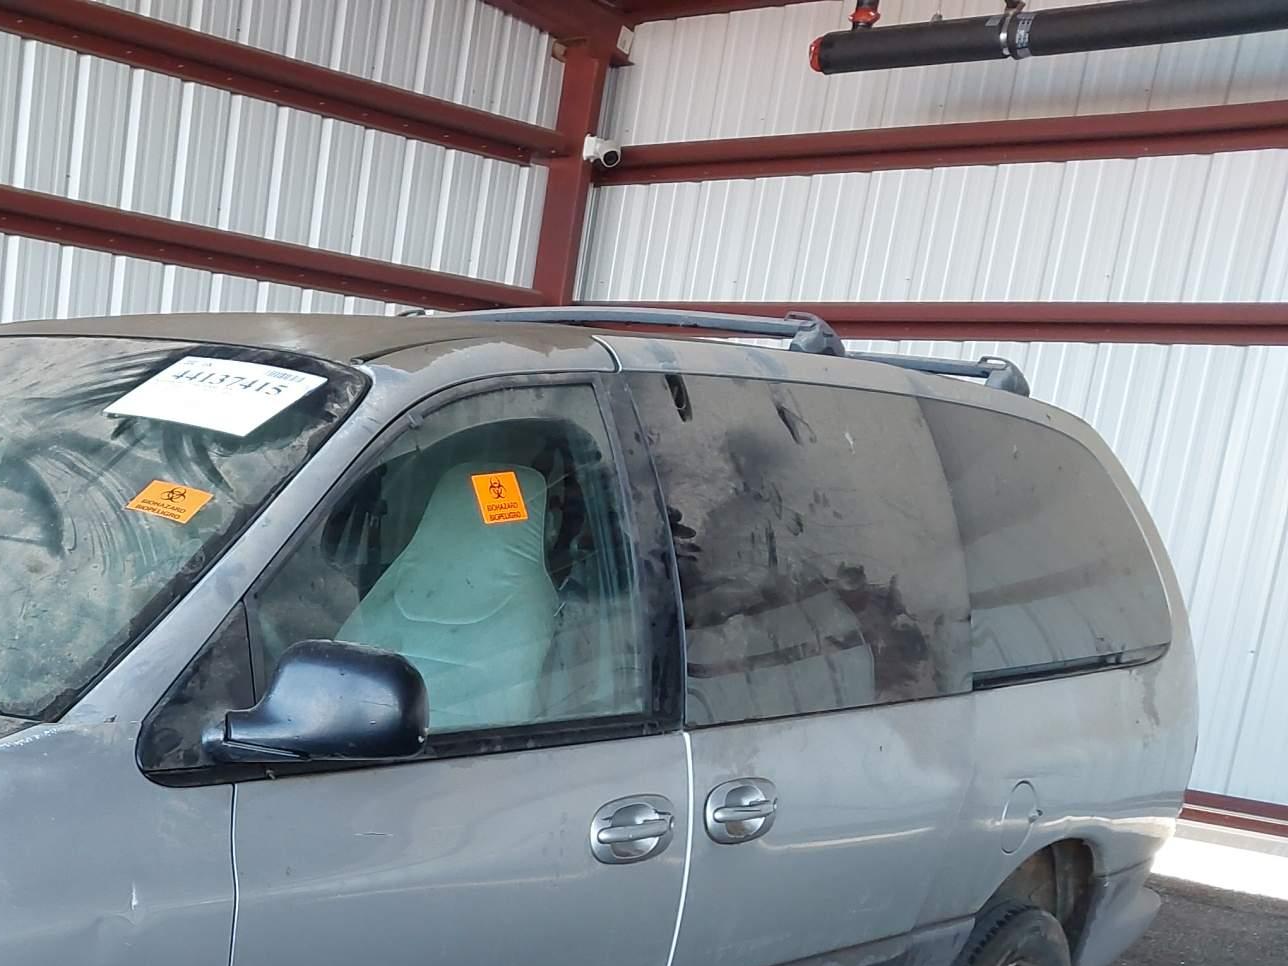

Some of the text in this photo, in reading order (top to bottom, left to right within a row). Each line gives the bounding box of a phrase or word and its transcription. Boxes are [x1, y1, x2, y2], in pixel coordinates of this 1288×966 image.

[172, 369, 288, 396] 44137415
[141, 498, 186, 514] BIOHAZARD
[487, 502, 518, 511] BIOHAZARD
